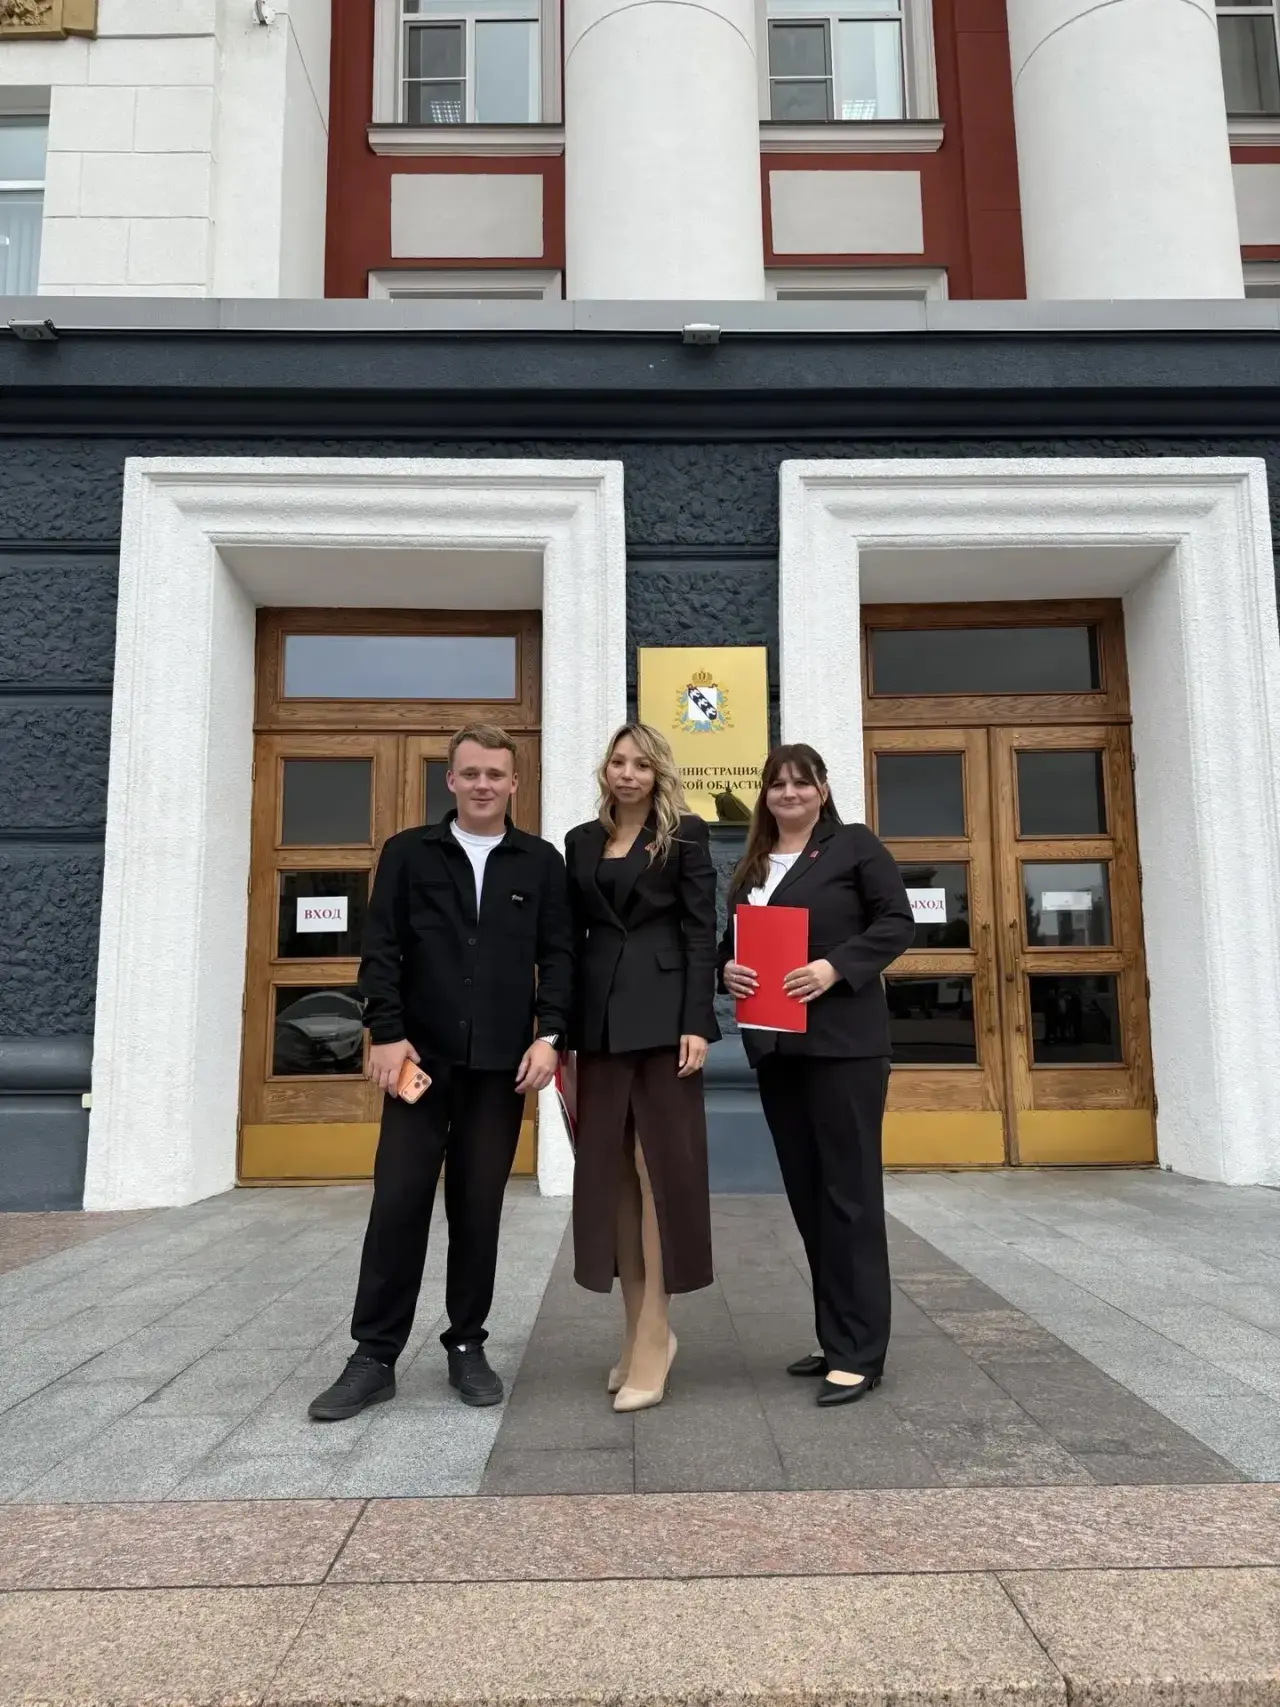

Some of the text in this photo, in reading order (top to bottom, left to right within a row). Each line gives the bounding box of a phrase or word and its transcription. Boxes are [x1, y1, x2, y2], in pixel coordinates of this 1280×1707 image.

[679, 766, 758, 776] ИНИСТРАЦИЯ
[910, 900, 944, 911] ЫХОД
[304, 908, 342, 920] ВХОД
